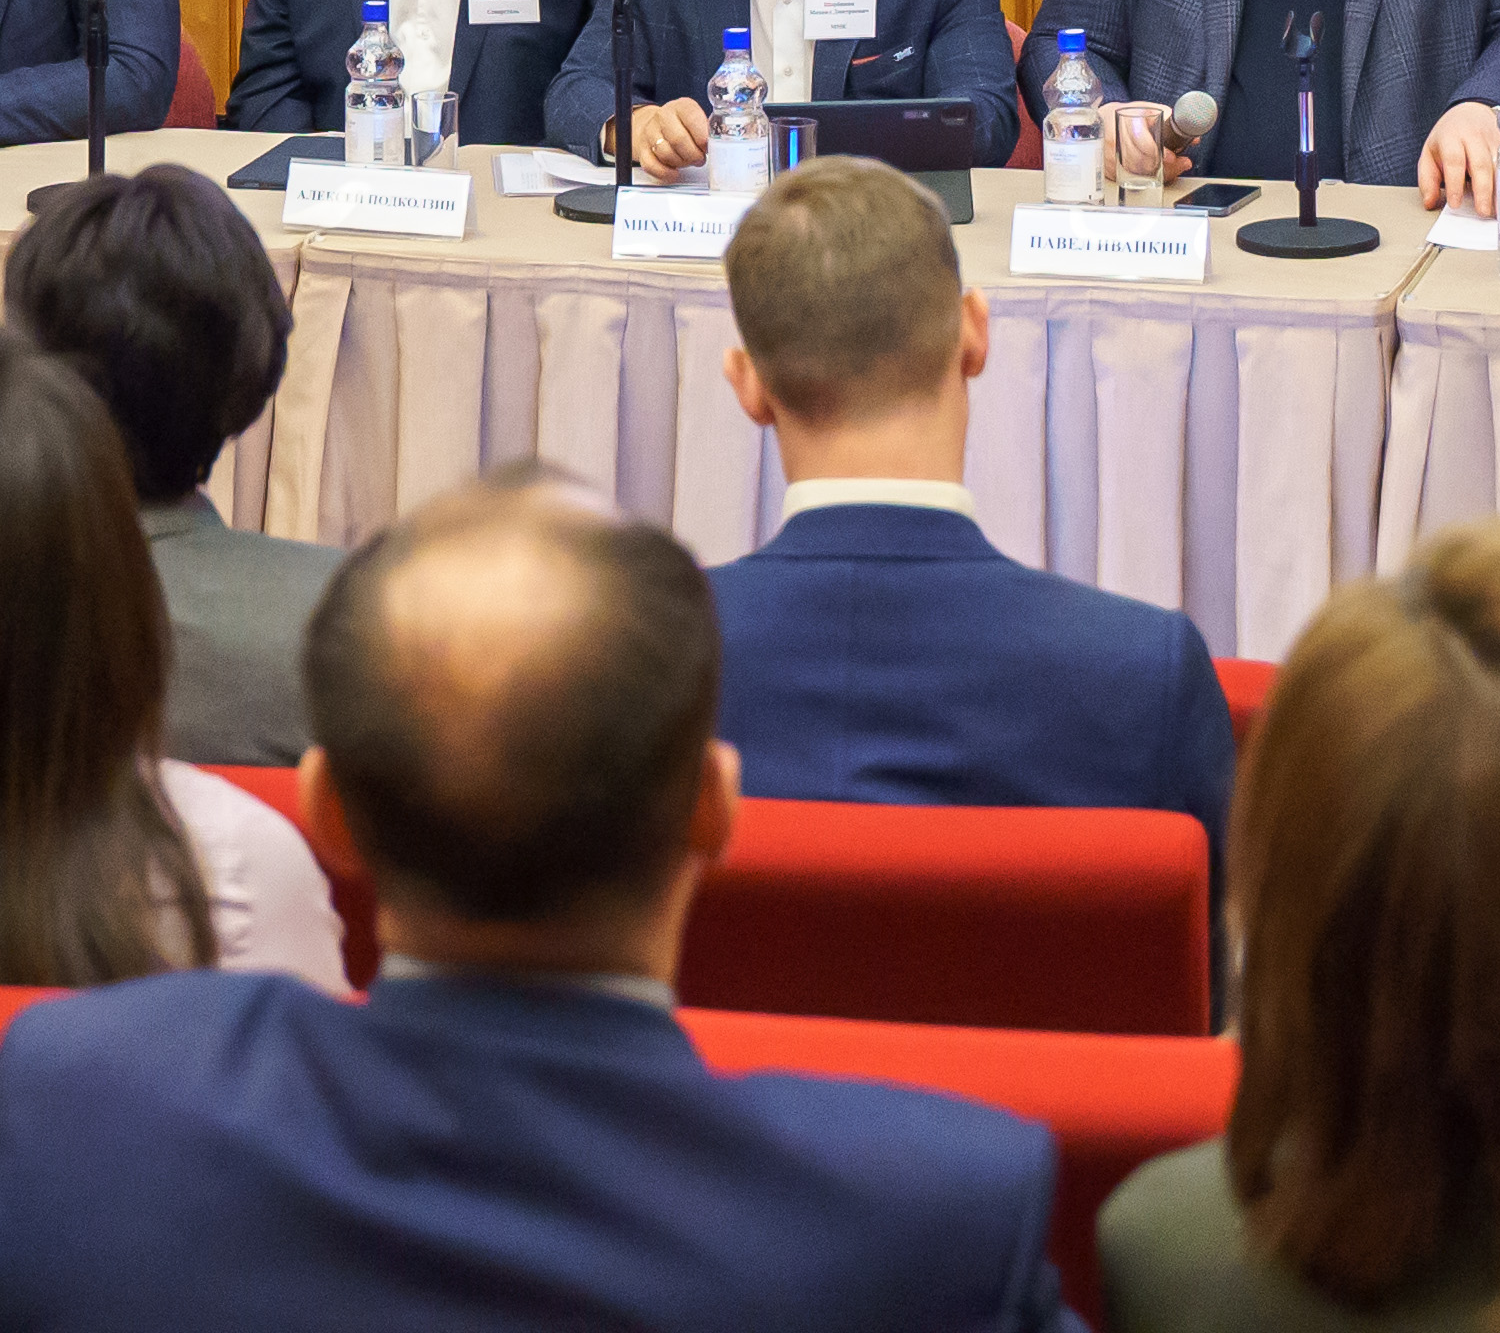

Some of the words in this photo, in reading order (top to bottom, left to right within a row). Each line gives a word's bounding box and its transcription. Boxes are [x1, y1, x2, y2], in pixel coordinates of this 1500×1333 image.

[368, 194, 456, 212] ПОДКОЛЗИН
[622, 218, 695, 233] МИХАИЛ
[1029, 235, 1091, 252] ПАВЕЛ
[1096, 239, 1188, 256] ИВАНКИН
